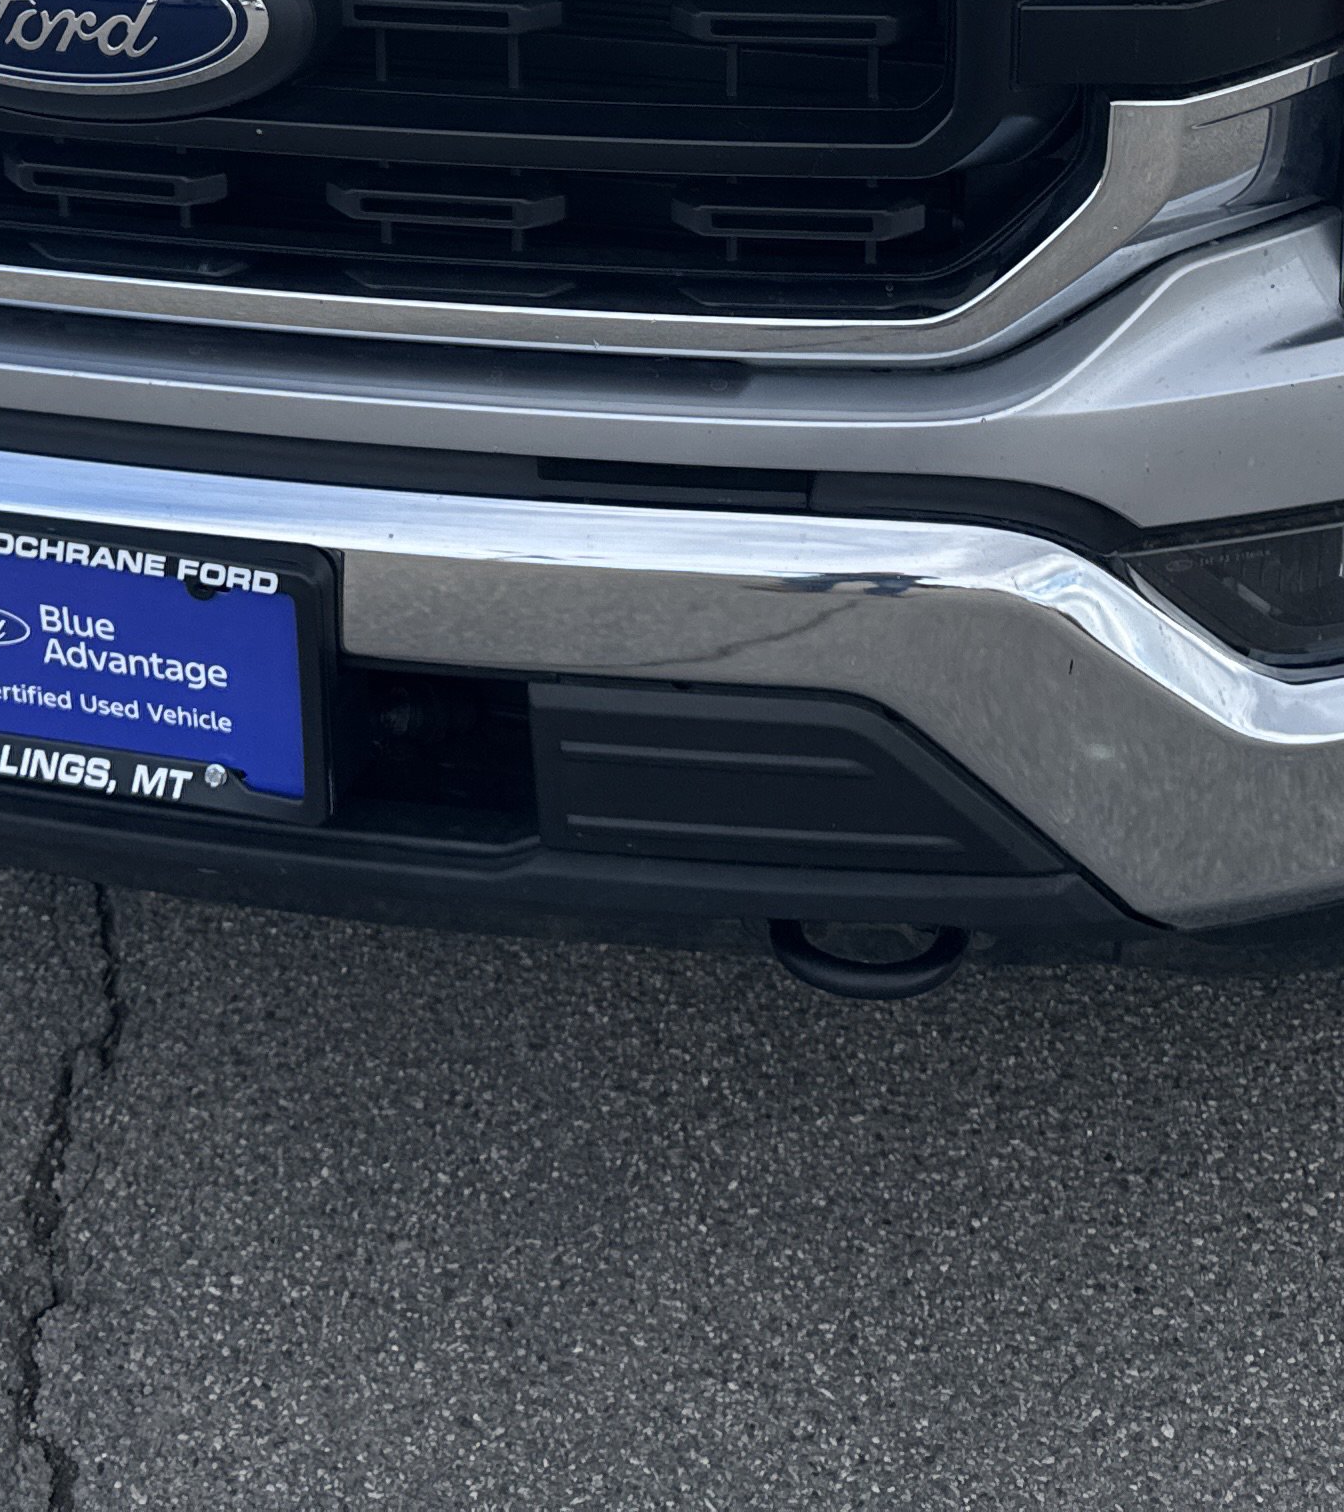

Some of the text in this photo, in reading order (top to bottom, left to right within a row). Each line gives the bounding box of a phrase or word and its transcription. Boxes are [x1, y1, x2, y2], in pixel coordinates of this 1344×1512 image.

[177, 559, 278, 595] FORD
[39, 604, 115, 641] Blue
[43, 638, 228, 690] Advantage
[80, 695, 139, 720] Used
[147, 703, 232, 733] Vehicle
[132, 764, 193, 800] MT
